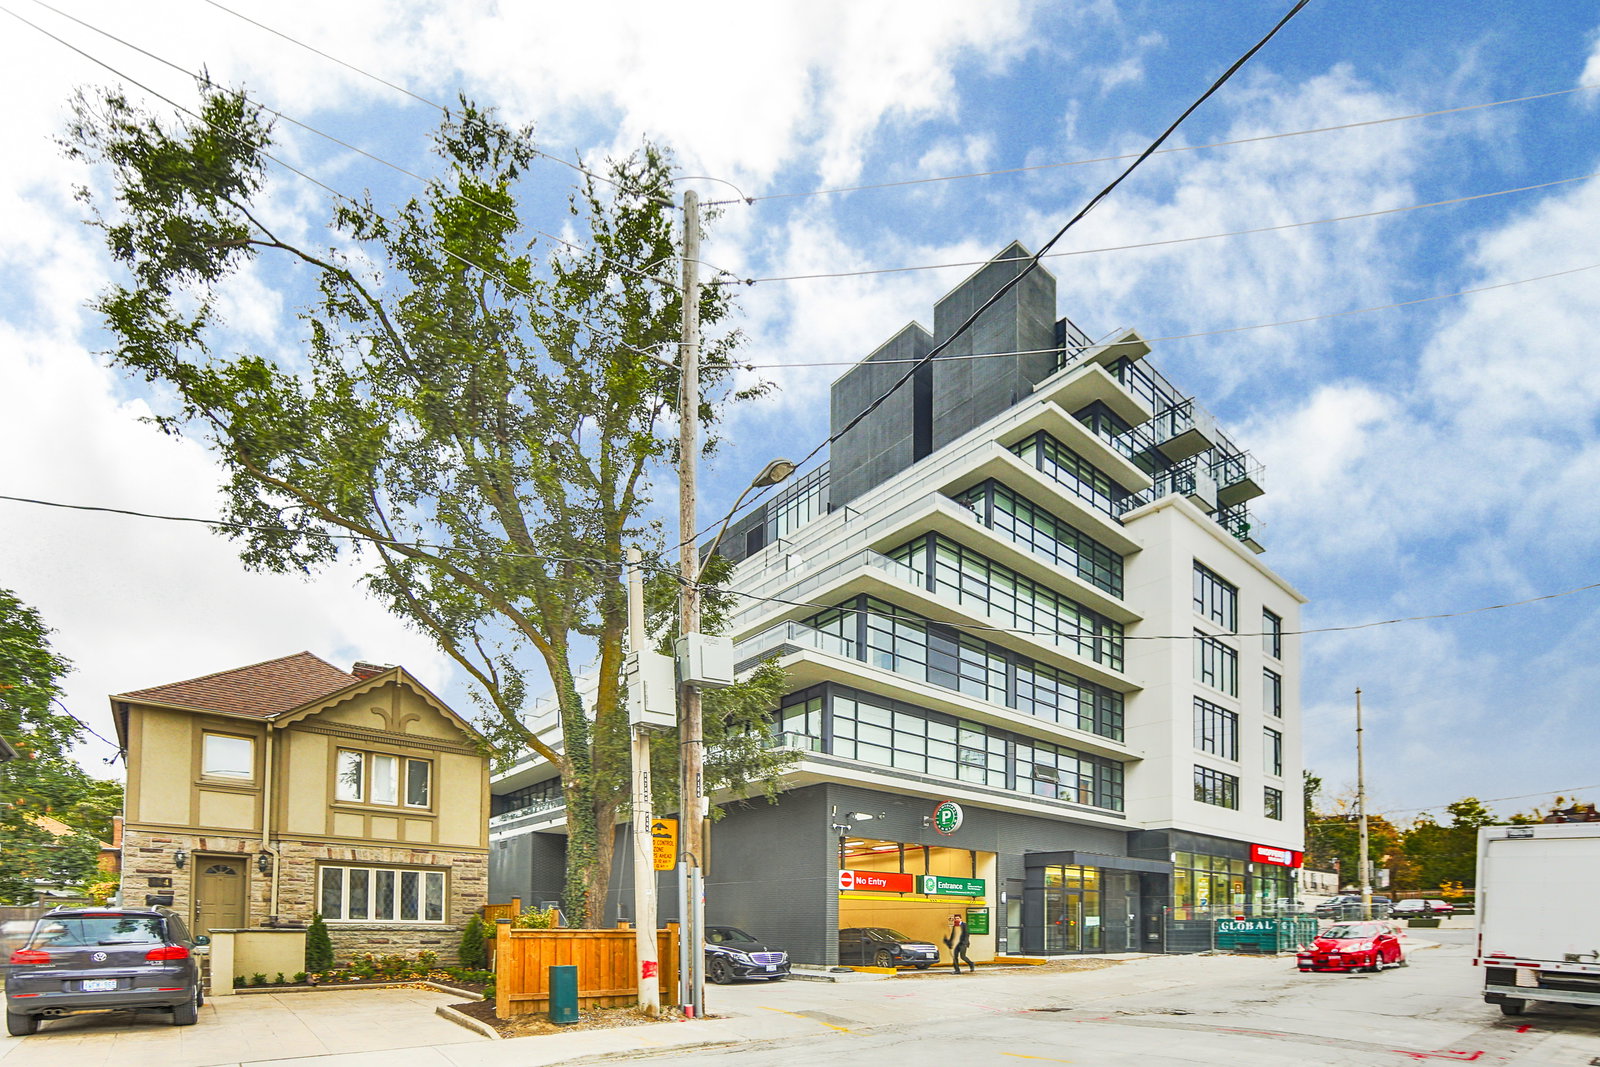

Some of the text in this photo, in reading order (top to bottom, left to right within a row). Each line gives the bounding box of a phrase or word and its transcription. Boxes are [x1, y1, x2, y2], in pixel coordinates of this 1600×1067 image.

[942, 811, 951, 822] P
[868, 877, 887, 887] Entry
[938, 881, 963, 890] Entrance
[1221, 921, 1273, 930] GLOBAL
